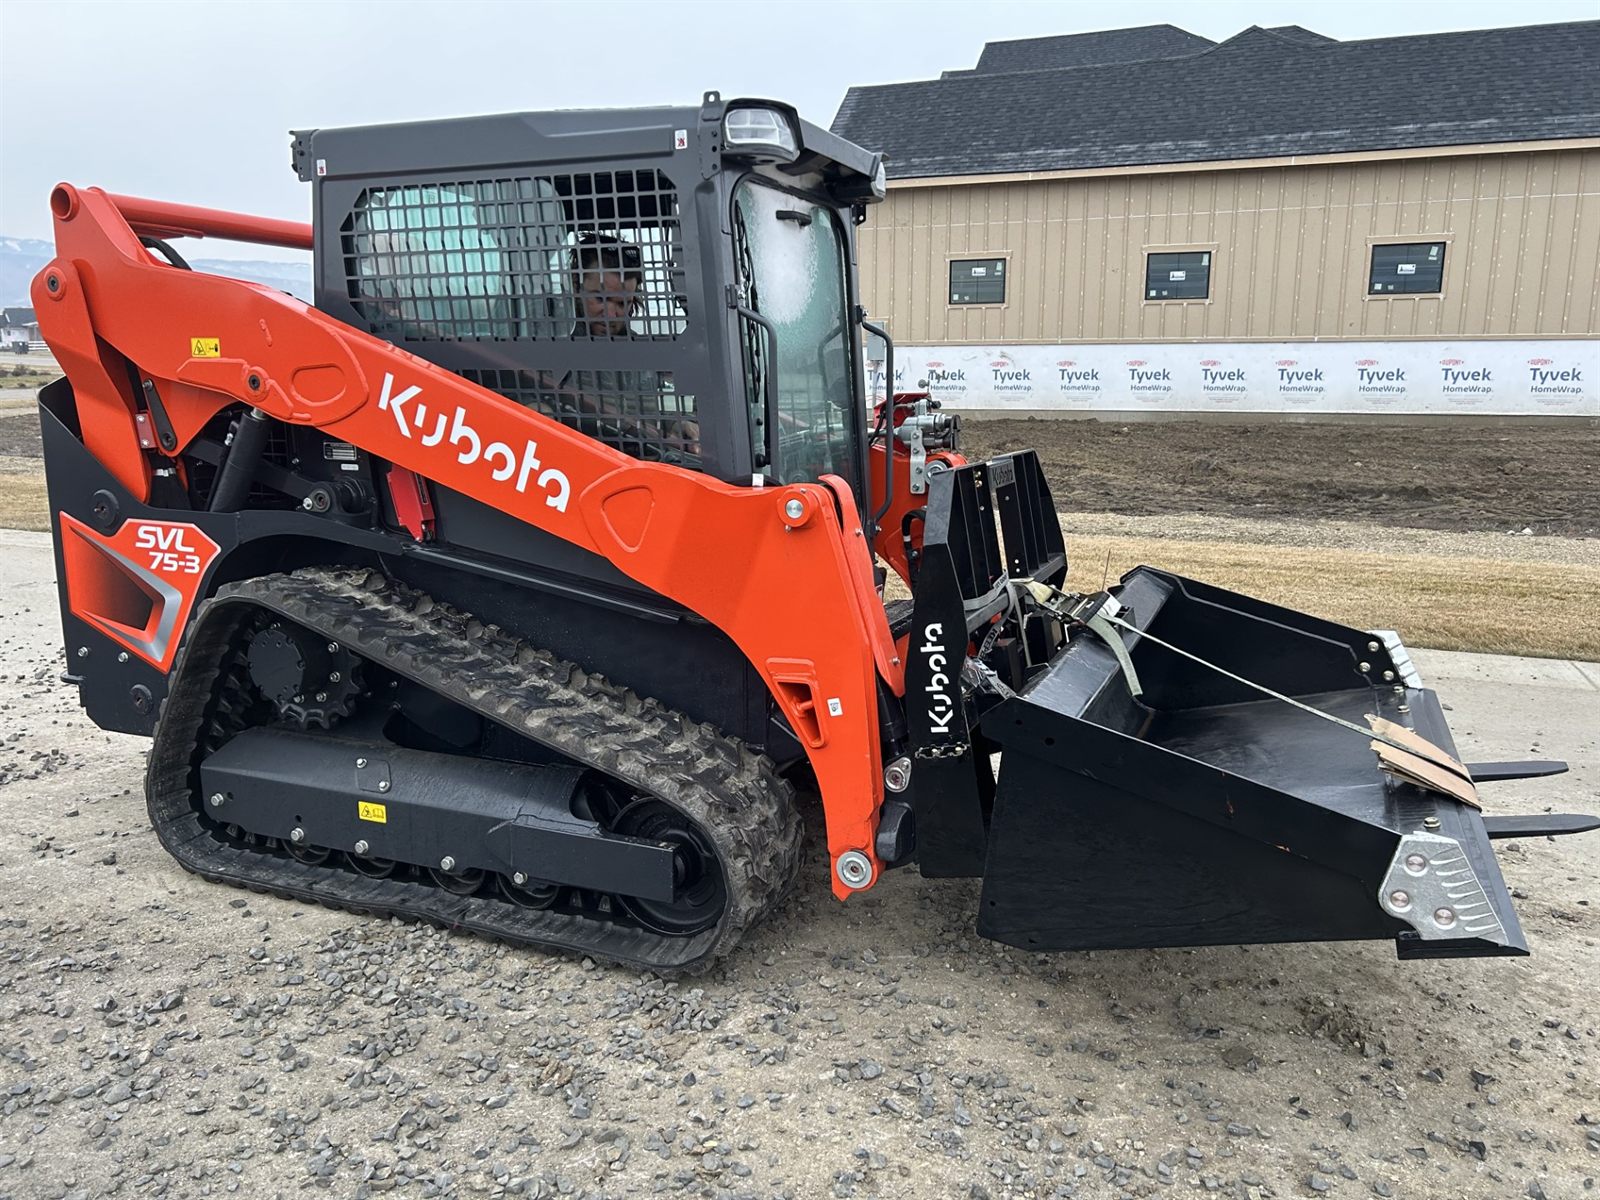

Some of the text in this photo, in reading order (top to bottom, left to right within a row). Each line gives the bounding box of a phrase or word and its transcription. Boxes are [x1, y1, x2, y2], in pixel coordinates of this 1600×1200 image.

[928, 369, 964, 383] Tyvek
[992, 369, 1031, 383] Tyvek
[1059, 369, 1099, 383] Tyvek
[1129, 368, 1170, 383] Tyvek
[1202, 368, 1245, 384] Tyvek
[1278, 368, 1323, 384] Tyvek
[1358, 368, 1405, 384] Tyvek
[1442, 368, 1491, 384] Tyvek
[1530, 368, 1582, 384] Tyvek
[1443, 385, 1492, 393] HomeWrap
[378, 372, 571, 513] Kubota
[135, 525, 195, 553] SVL
[148, 552, 201, 574] 75-3
[920, 622, 954, 733] Kubota
